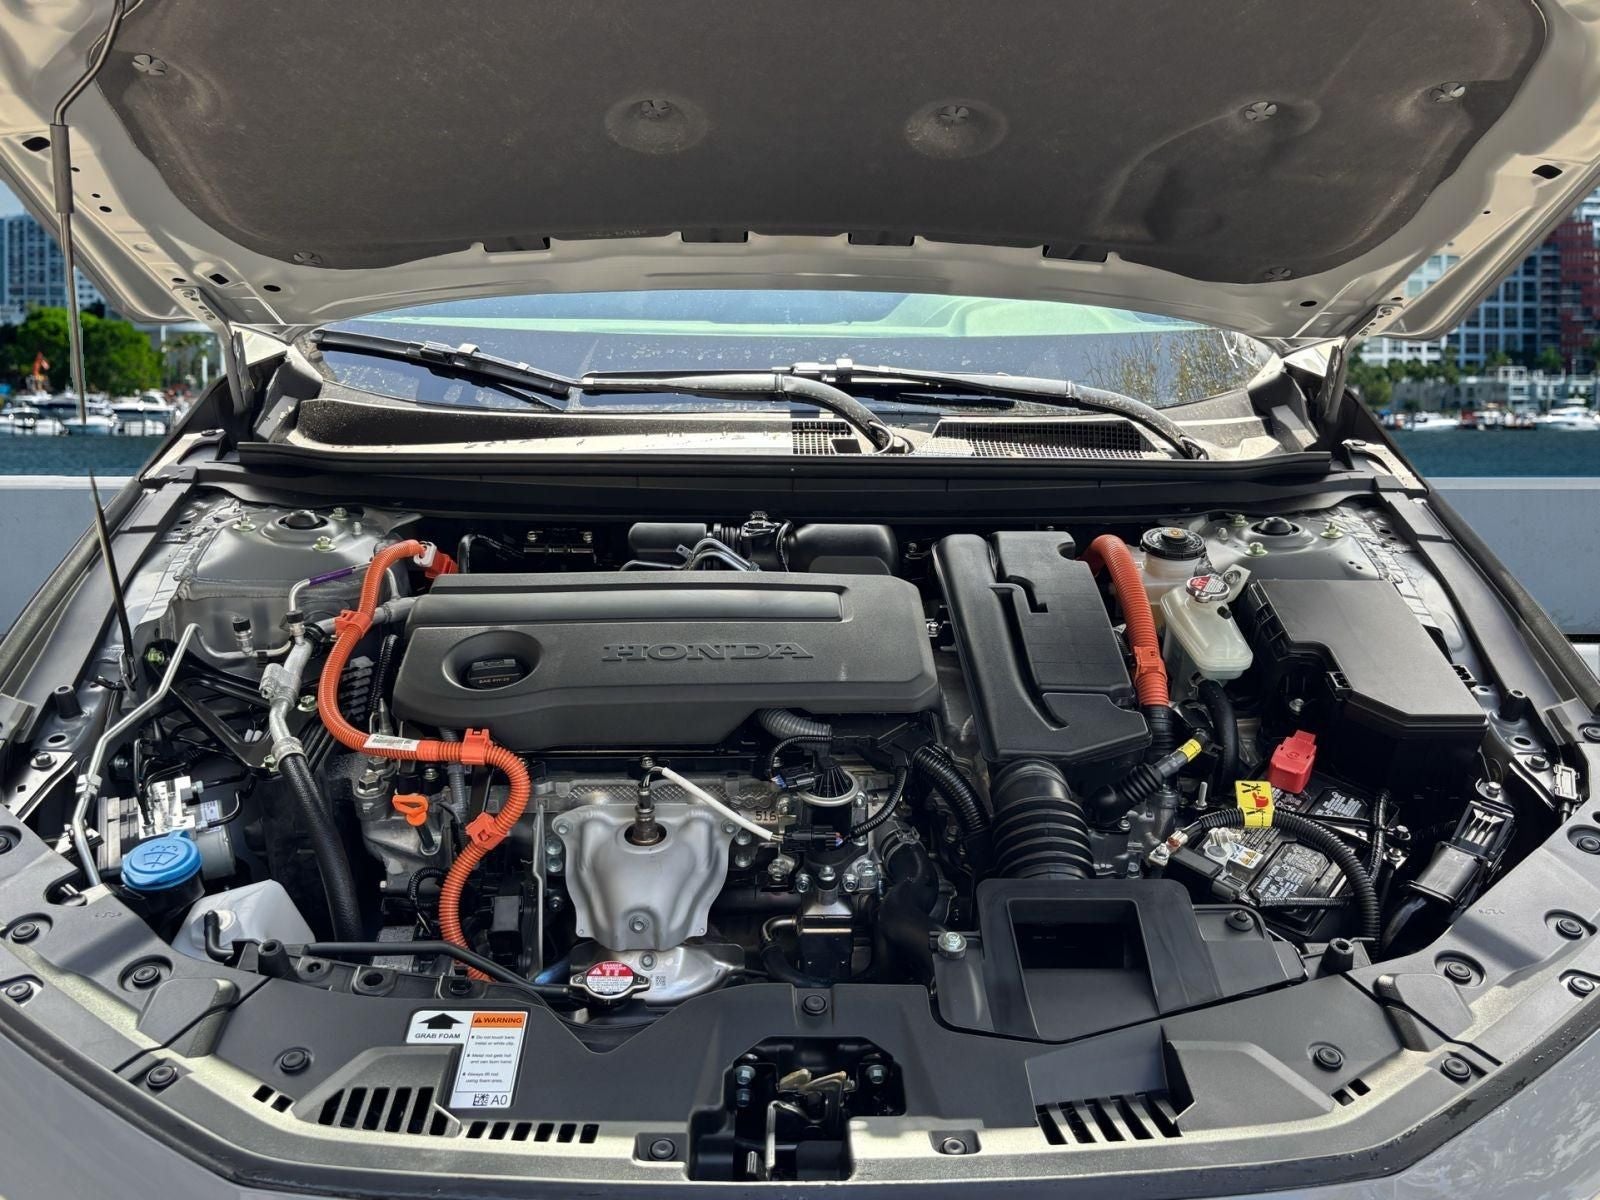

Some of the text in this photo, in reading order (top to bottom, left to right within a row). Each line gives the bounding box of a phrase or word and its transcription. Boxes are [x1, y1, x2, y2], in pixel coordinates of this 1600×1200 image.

[601, 641, 814, 662] HONDA
[755, 811, 777, 822] 516
[490, 1094, 508, 1106] A0
